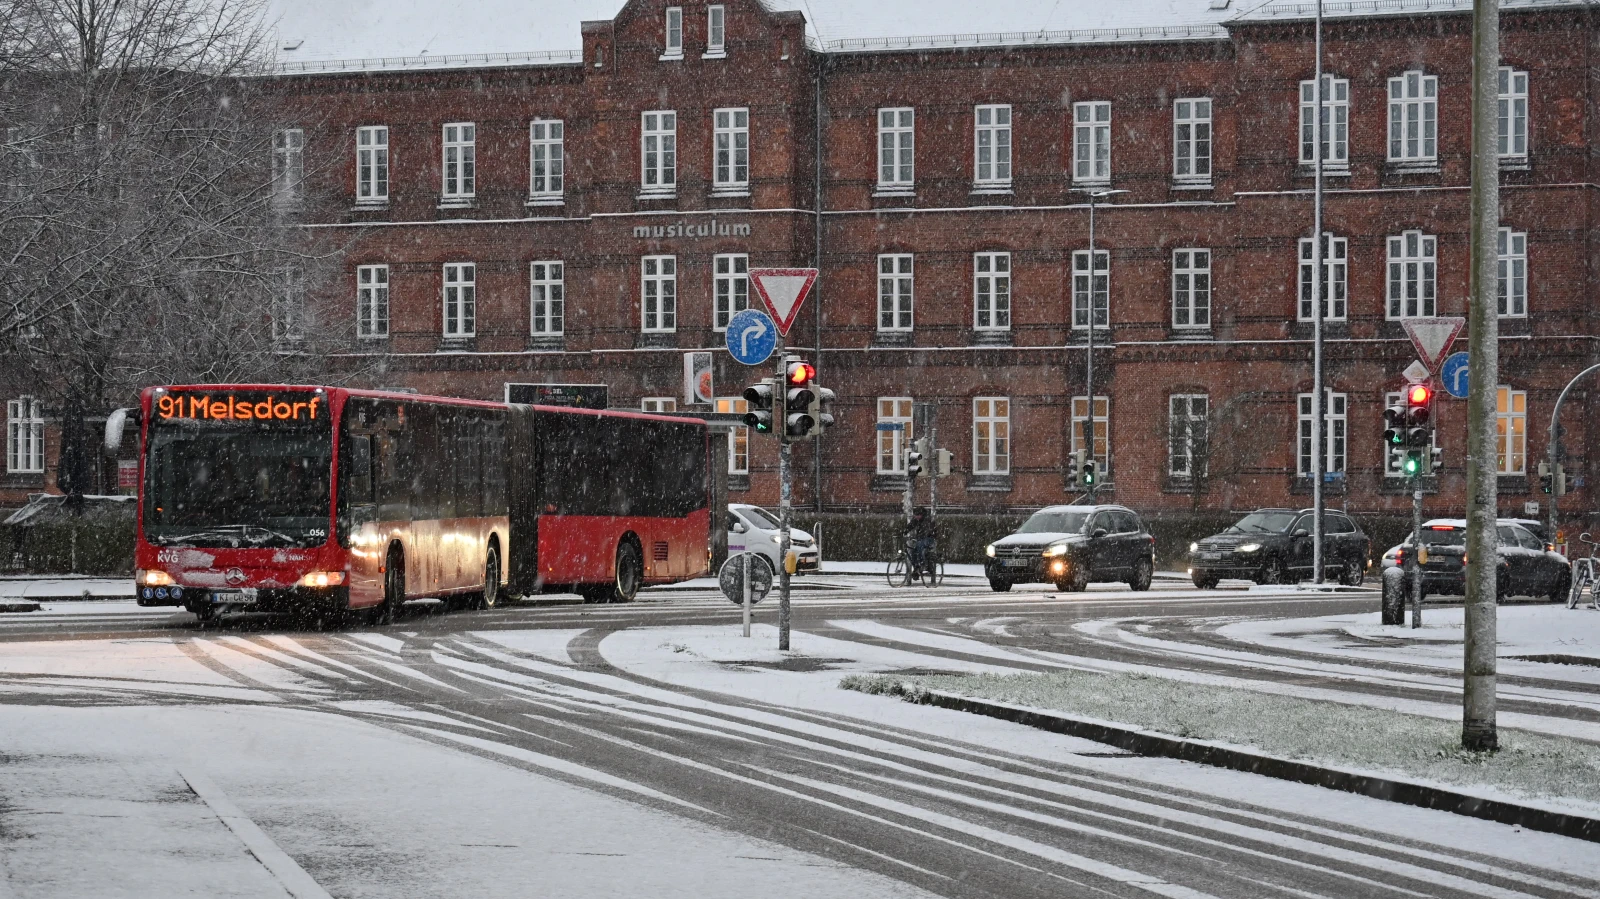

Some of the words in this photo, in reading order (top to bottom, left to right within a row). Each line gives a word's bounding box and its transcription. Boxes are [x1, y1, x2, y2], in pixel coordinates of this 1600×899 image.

[633, 219, 751, 238] musiculum
[159, 395, 184, 419] 91
[190, 395, 320, 420] Melsdorf
[309, 528, 325, 537] 056
[157, 554, 179, 563] KVG
[219, 593, 229, 602] KI
